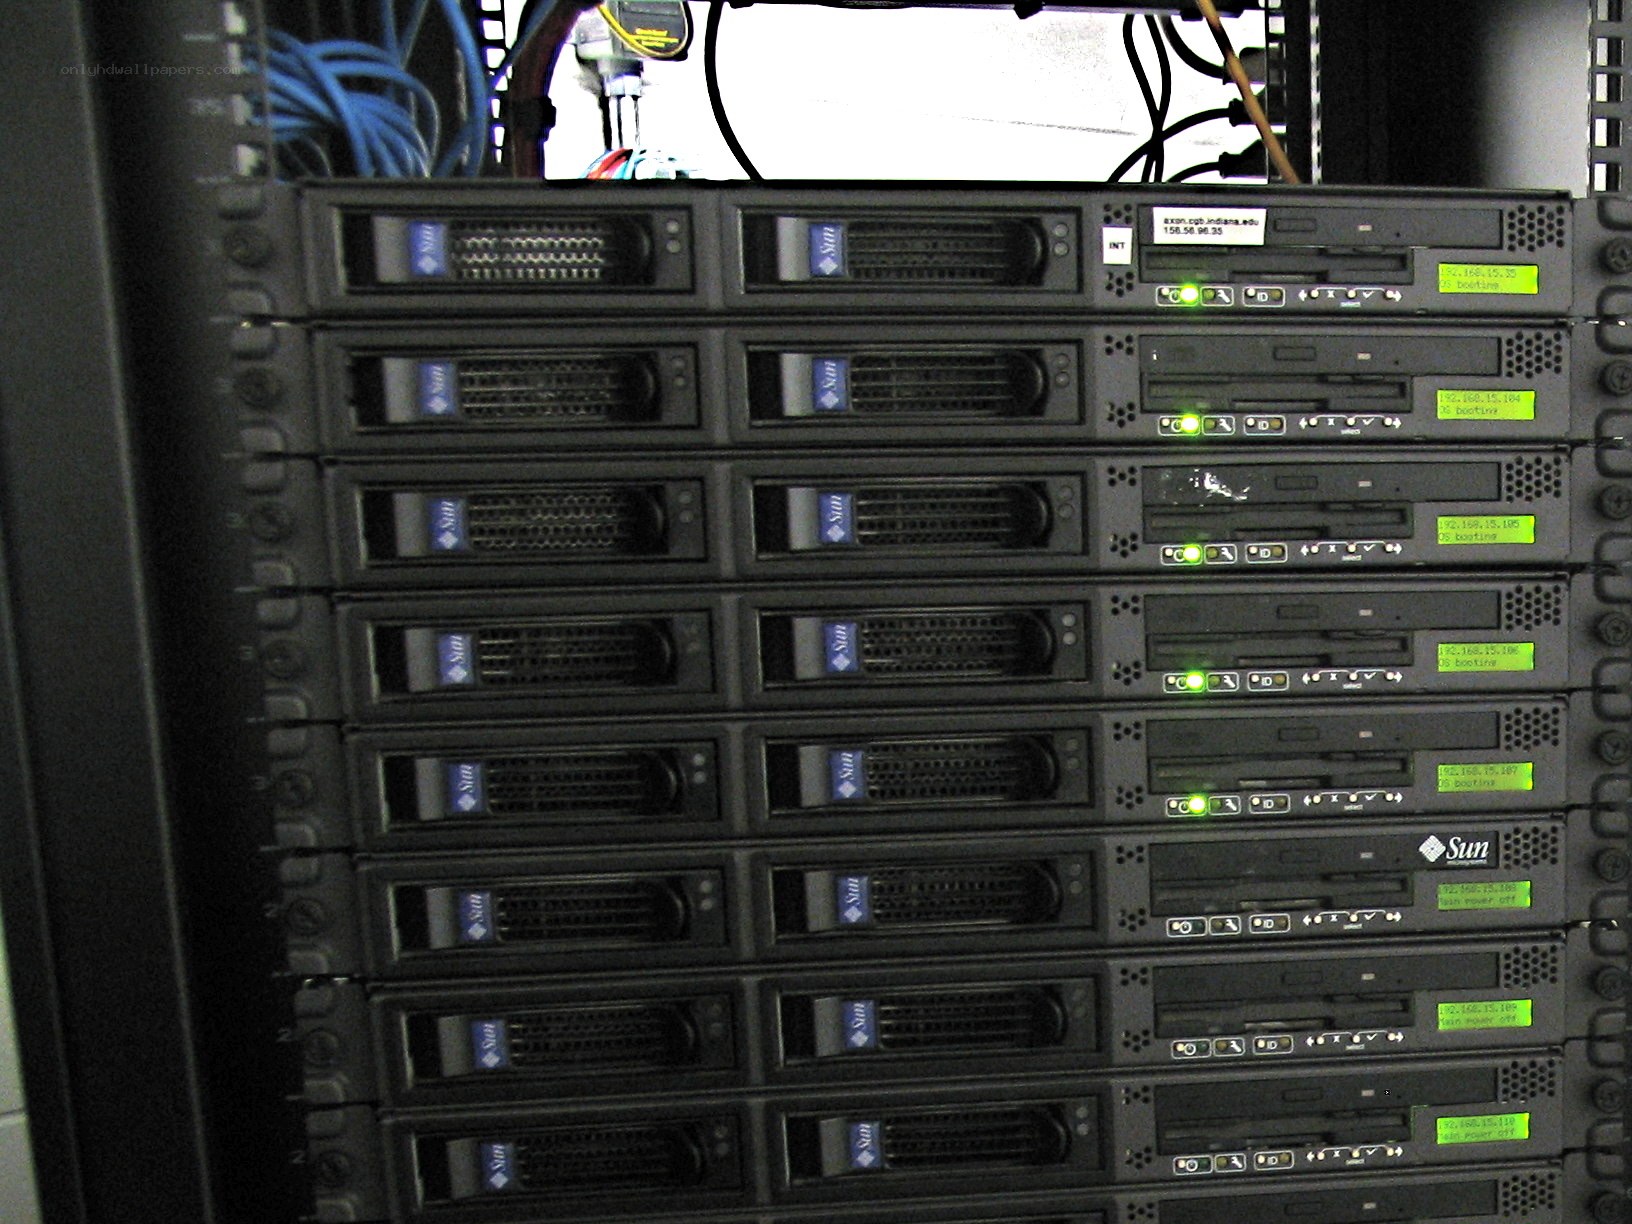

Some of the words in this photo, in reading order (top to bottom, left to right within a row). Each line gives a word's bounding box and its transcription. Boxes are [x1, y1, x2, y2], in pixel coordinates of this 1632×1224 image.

[1108, 241, 1125, 250] INT
[1457, 281, 1499, 290] booting
[1257, 292, 1268, 301] ID
[1456, 407, 1497, 415] booting
[1258, 421, 1269, 430] ID
[1455, 532, 1497, 541] booting
[1260, 549, 1270, 558] ID
[1455, 659, 1496, 667] booting
[1262, 677, 1272, 686] ID
[1455, 779, 1495, 787] booting
[1263, 800, 1274, 808] ID
[1446, 836, 1489, 859] Sun
[1264, 919, 1274, 928] ID
[1267, 1041, 1277, 1049] ID
[1268, 1156, 1278, 1165] ID
